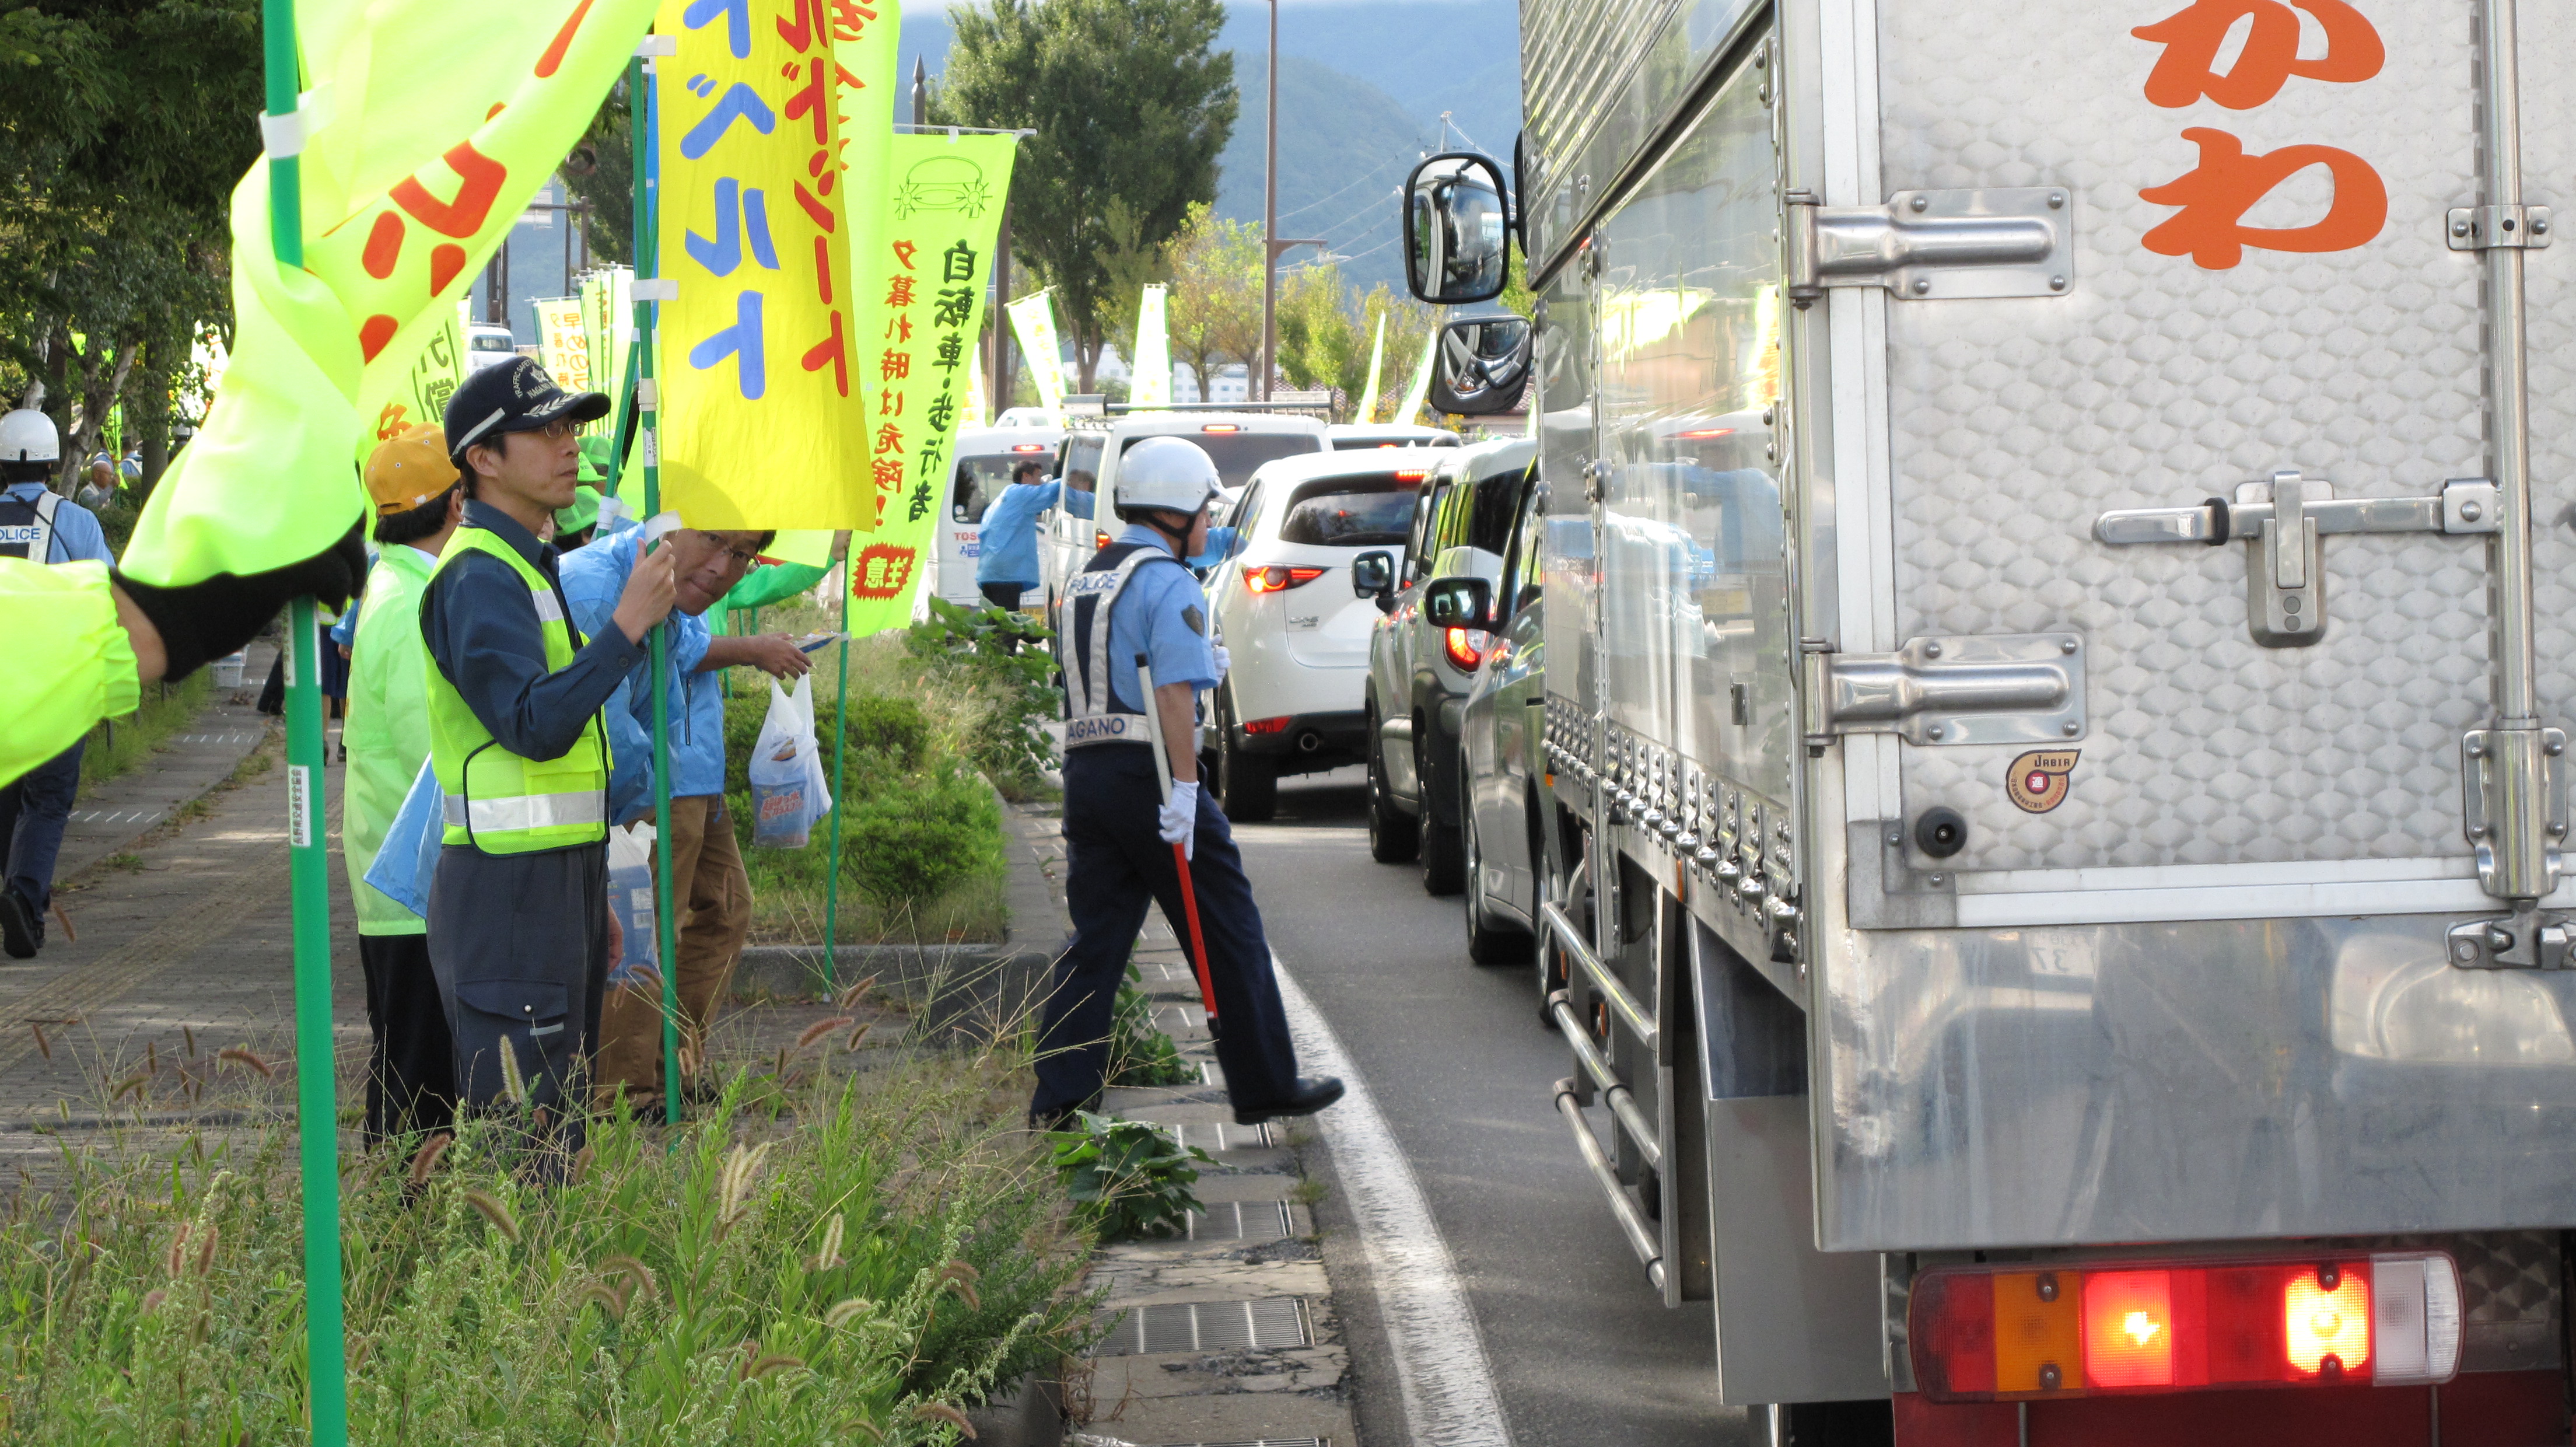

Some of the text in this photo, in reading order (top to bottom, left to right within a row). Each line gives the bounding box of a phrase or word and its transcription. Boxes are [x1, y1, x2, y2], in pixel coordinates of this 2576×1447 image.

[954, 532, 980, 541] TOS
[1068, 717, 1125, 740] AGANO
[2035, 754, 2070, 767] JABIA
